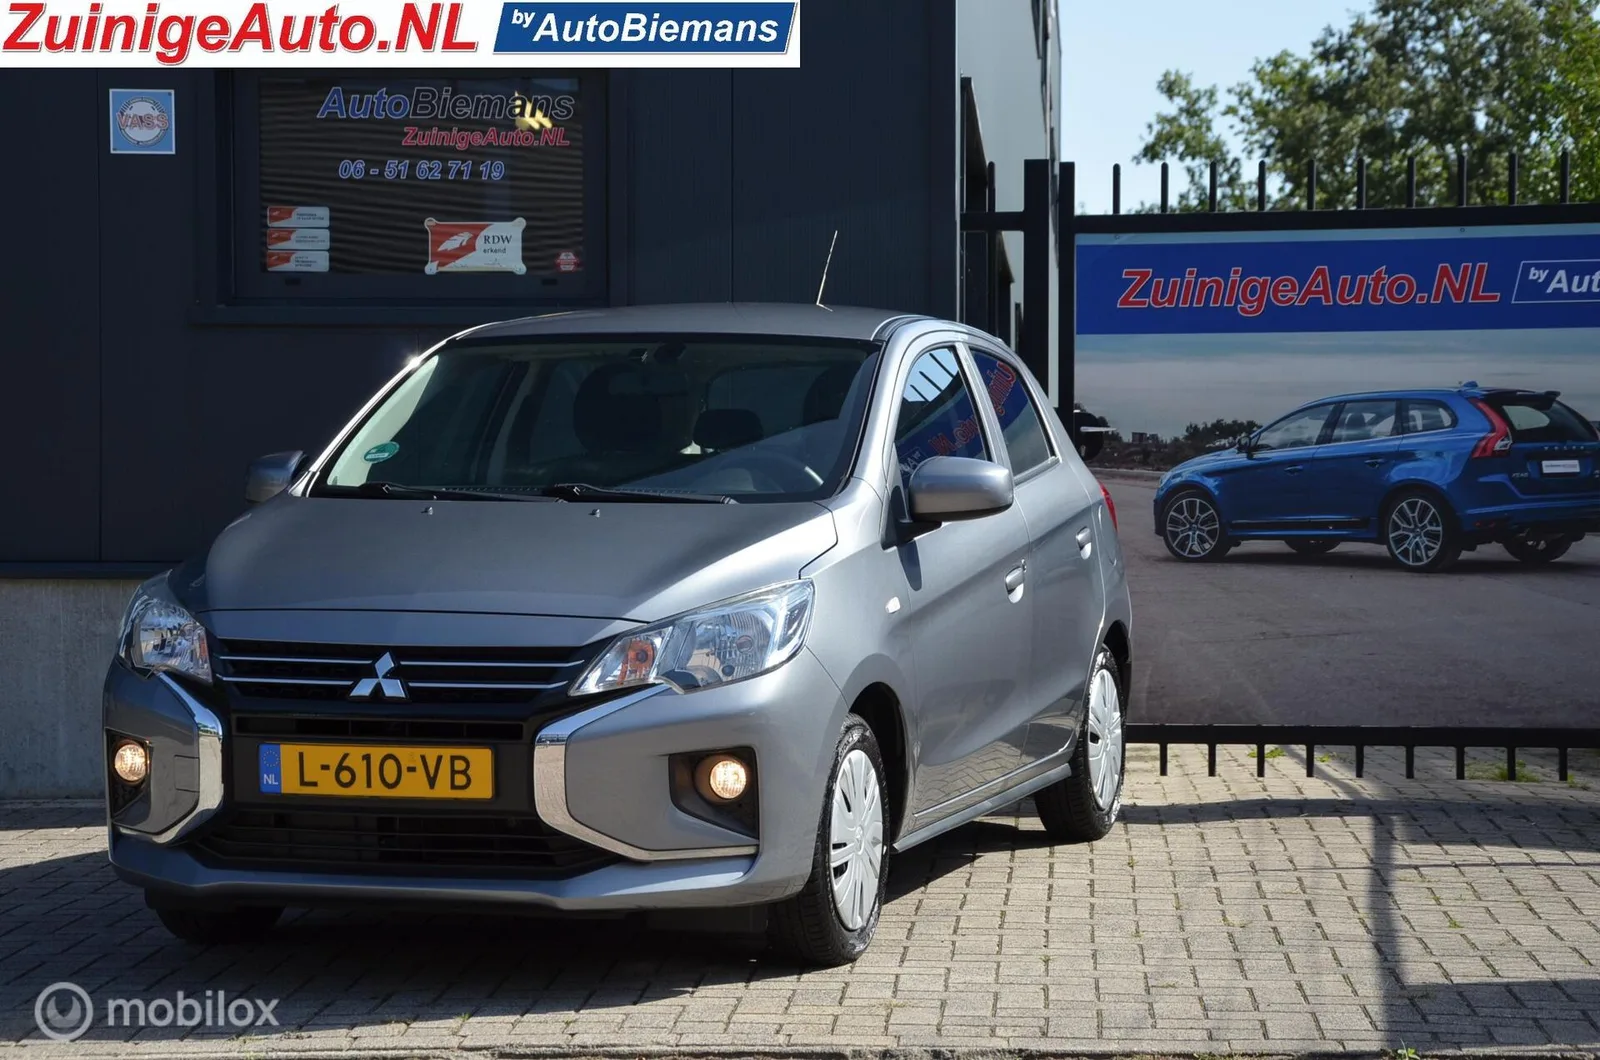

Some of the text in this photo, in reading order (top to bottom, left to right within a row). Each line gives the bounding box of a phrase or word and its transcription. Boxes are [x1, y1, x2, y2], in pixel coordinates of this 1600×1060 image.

[316, 87, 575, 119] AutoBiemans
[402, 126, 571, 150] ZuinigeAuto.NL
[338, 159, 365, 180] 06
[384, 159, 409, 180] 51
[415, 160, 442, 180] 62
[448, 160, 473, 180] 71
[479, 160, 505, 180] 19
[483, 235, 513, 245] RDW
[1116, 262, 1502, 317] ZuinigeAuto.NL
[1528, 266, 1550, 283] by
[263, 773, 279, 786] NL
[297, 751, 473, 791] L-610-VB
